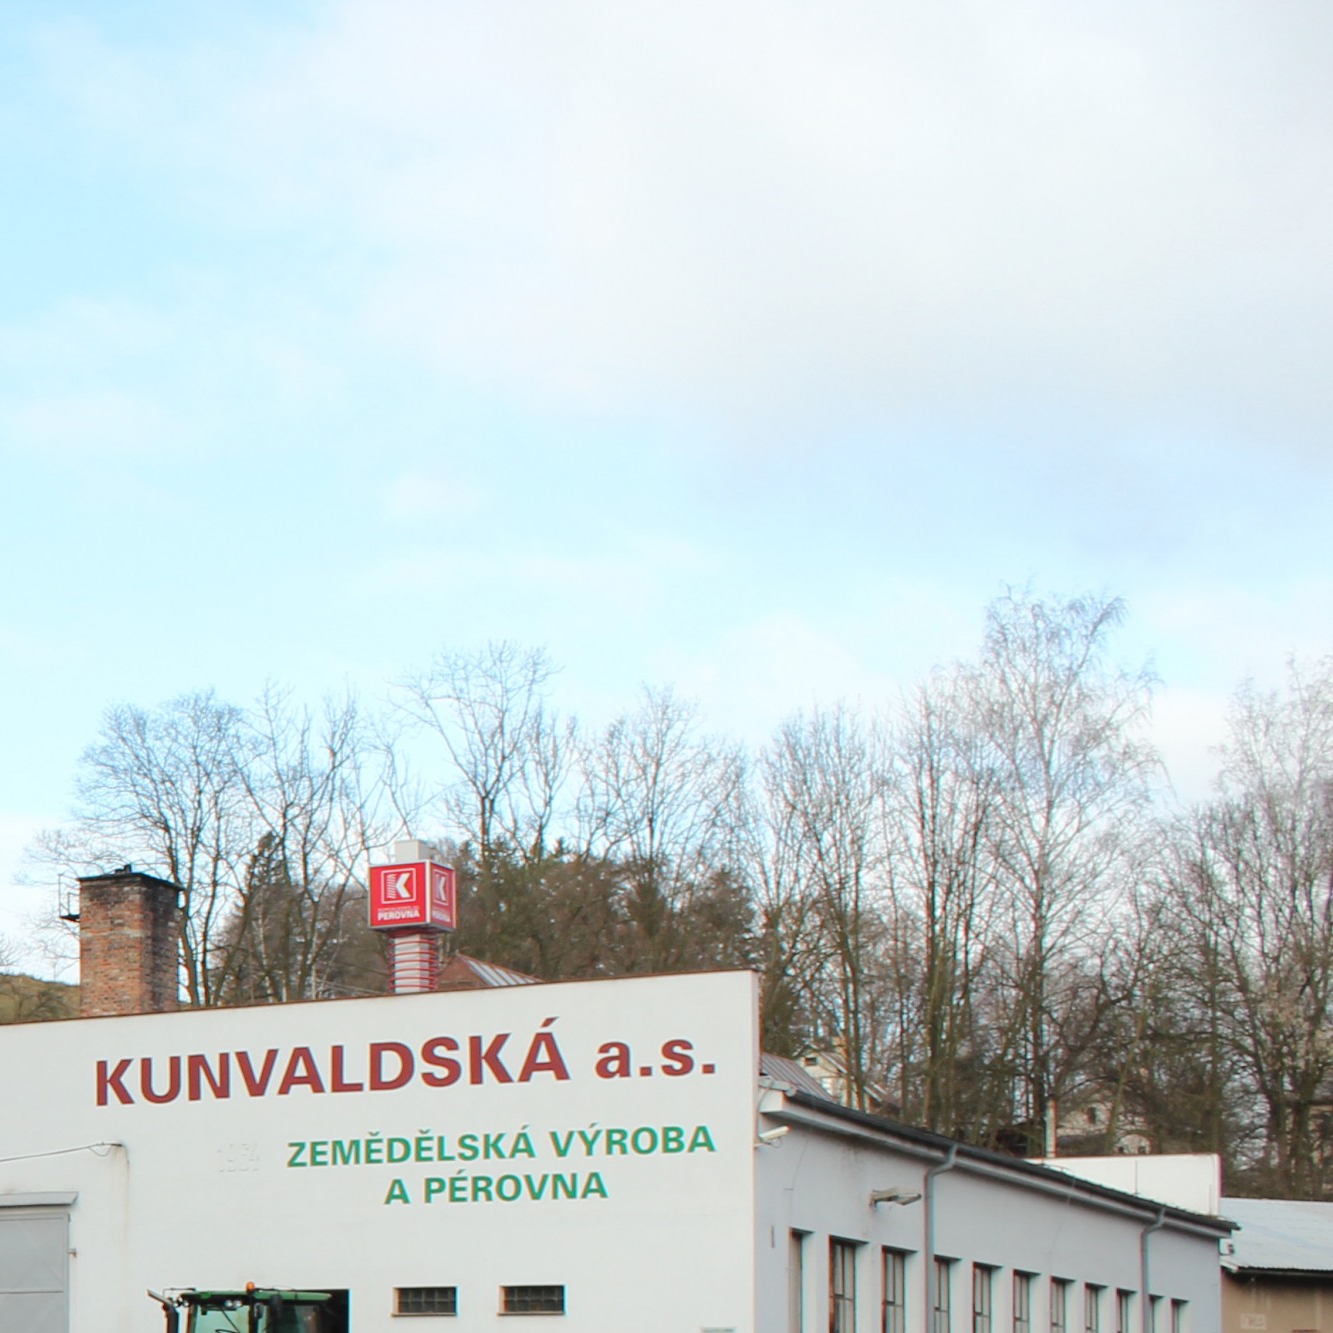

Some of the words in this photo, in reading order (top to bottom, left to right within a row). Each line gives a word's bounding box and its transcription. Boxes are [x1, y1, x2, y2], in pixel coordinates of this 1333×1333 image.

[377, 909, 421, 921] PEROVNA
[97, 1018, 570, 1106] KUNVALDSKÁ
[594, 1038, 717, 1079] a.s.
[286, 1124, 536, 1168] ZEMĚDĚLSKÁ
[550, 1121, 717, 1159] VÝROBA
[384, 1178, 411, 1205] A
[424, 1167, 609, 1203] PÉROVNA
